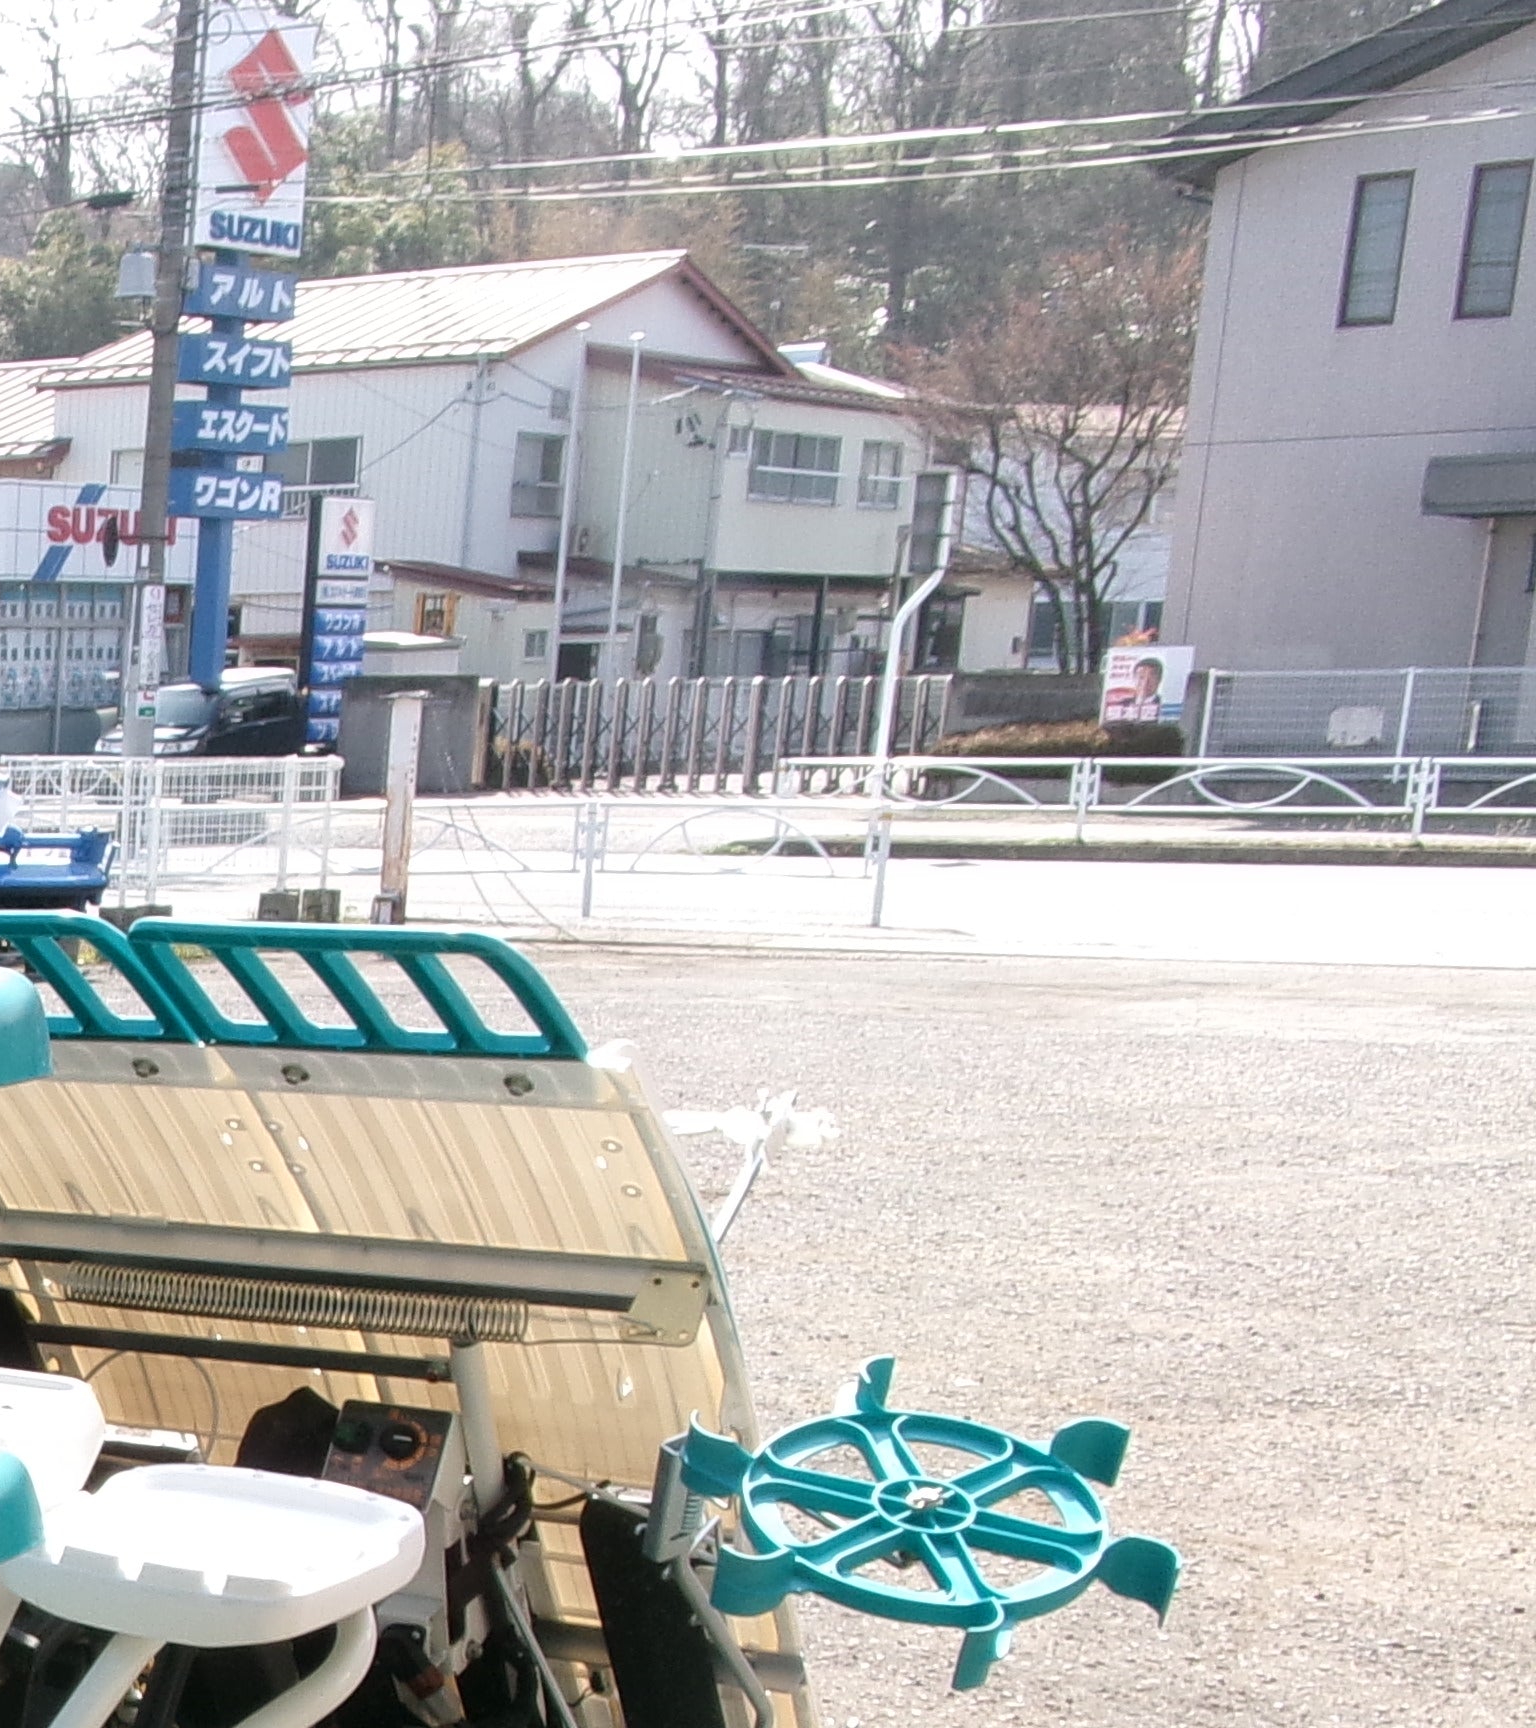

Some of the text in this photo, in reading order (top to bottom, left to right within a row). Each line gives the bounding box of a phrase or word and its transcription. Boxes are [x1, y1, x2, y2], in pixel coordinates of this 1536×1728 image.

[210, 210, 300, 250] SUZUKI
[210, 273, 292, 313] アルト
[203, 341, 290, 378] スイフト
[197, 410, 289, 447] エスクード
[195, 475, 282, 512] ワゴンR
[48, 505, 176, 546] SUZUI
[326, 554, 369, 570] SUZUKI
